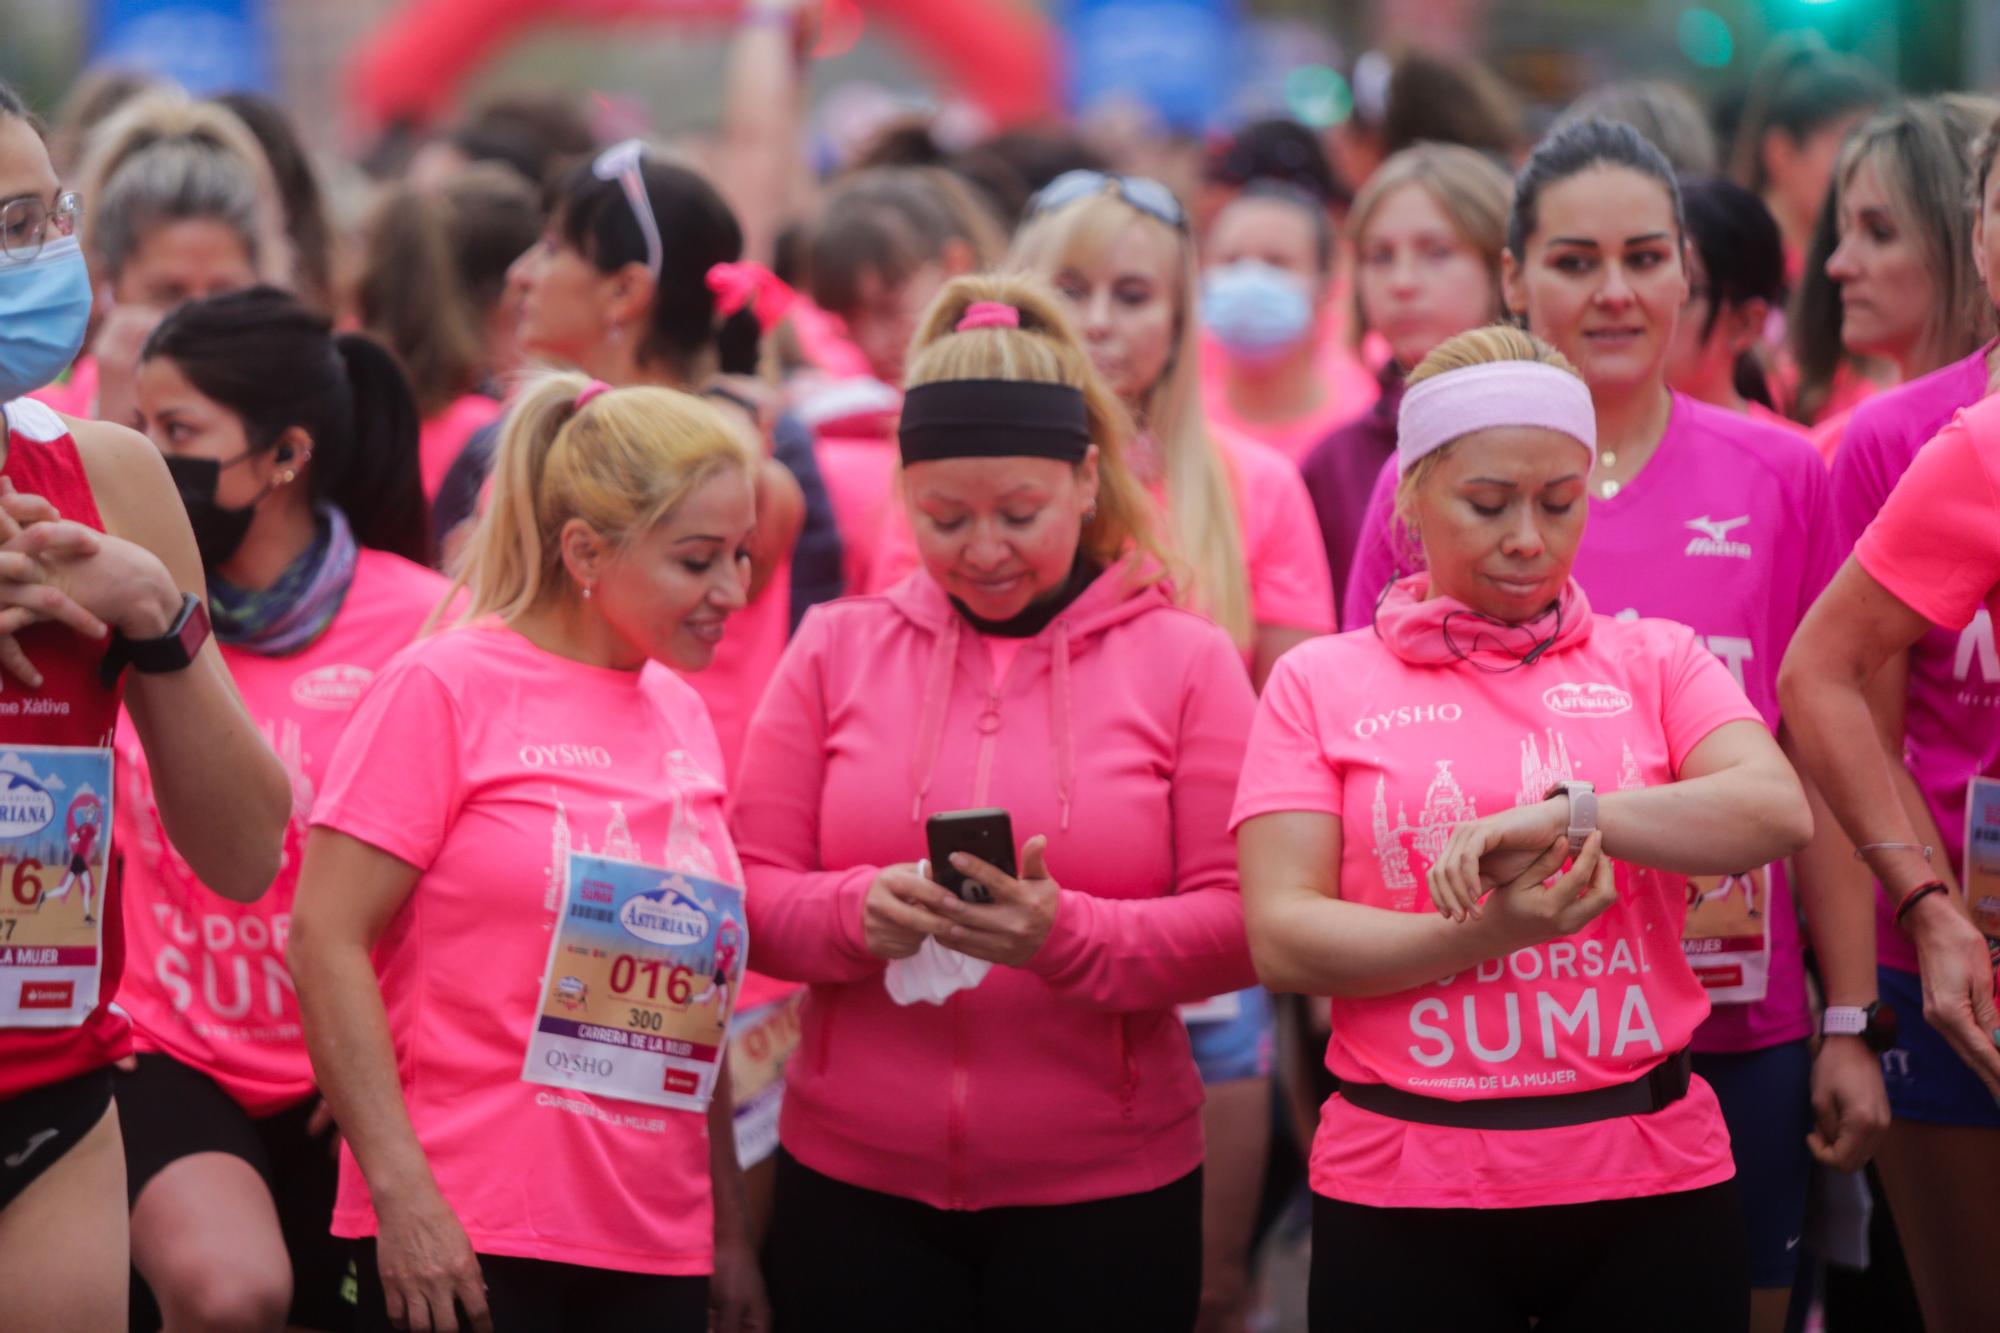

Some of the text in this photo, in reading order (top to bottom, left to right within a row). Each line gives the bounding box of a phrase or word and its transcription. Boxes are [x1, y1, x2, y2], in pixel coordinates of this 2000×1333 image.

[1551, 693, 1628, 709] ASTURIANA
[1355, 704, 1461, 740] OYSHO
[519, 744, 612, 769] OYSHO
[17, 948, 59, 963] MUJER
[610, 952, 695, 1005] 016
[628, 1008, 663, 1032] 300
[1409, 984, 1663, 1067] SUMA
[577, 1024, 629, 1046] CARRERA
[630, 1033, 647, 1049] DE
[649, 1037, 664, 1052] LA
[544, 1048, 614, 1078] OYSHO
[1408, 1069, 1577, 1089] CARRERA DE LA MUJER
